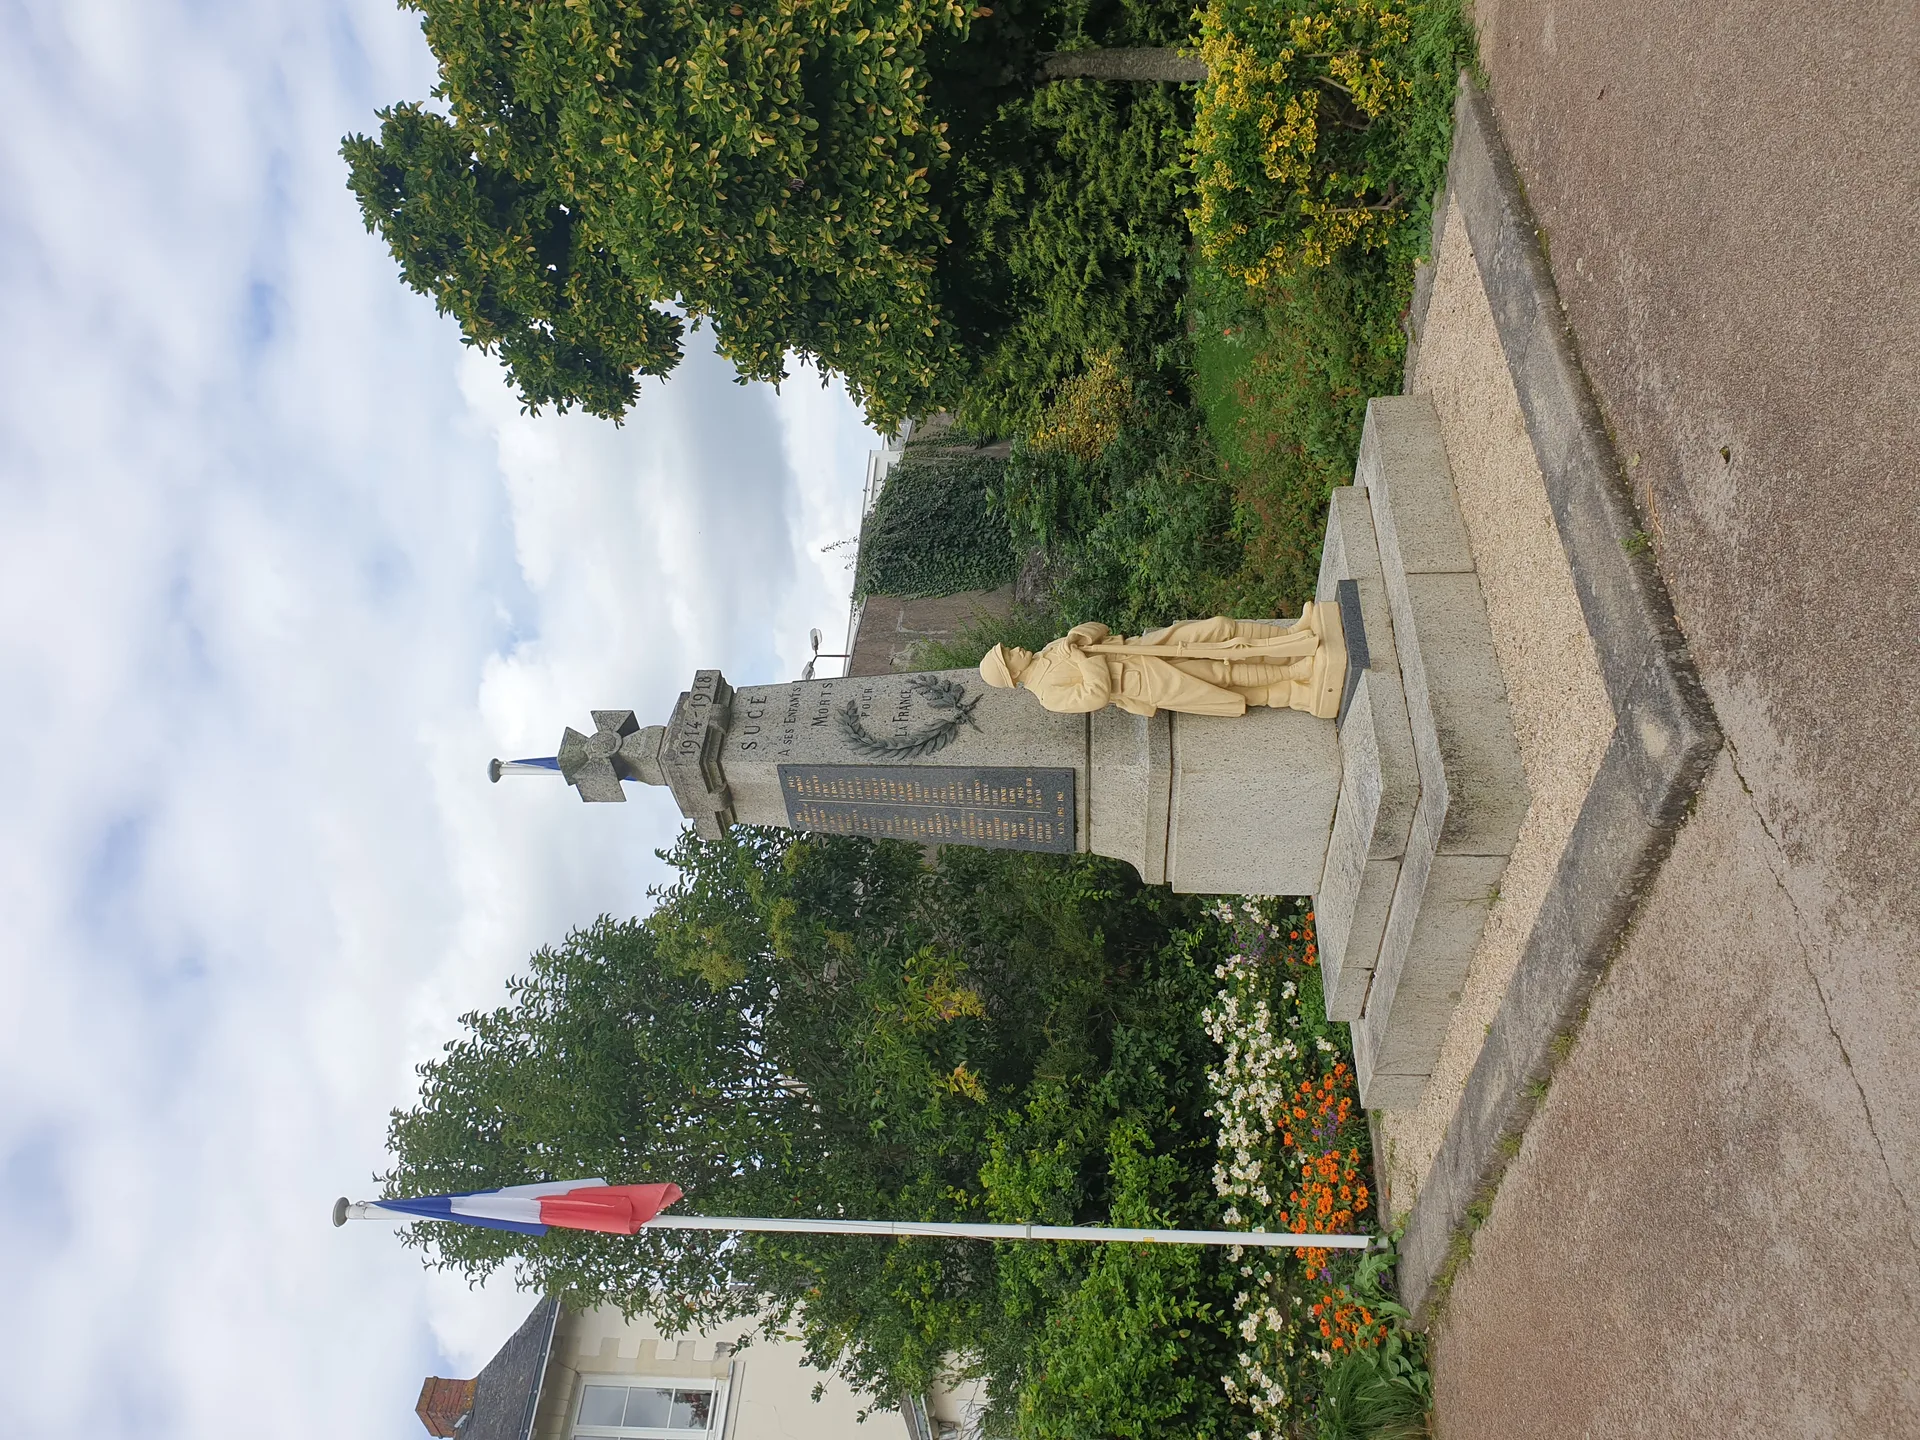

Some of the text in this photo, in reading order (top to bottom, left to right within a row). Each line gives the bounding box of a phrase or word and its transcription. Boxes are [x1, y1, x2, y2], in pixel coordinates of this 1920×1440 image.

[777, 686, 802, 757] A SES ENFANTS
[811, 682, 834, 728] MORTS
[860, 688, 873, 718] POUR
[892, 689, 912, 737] LA FRANCE
